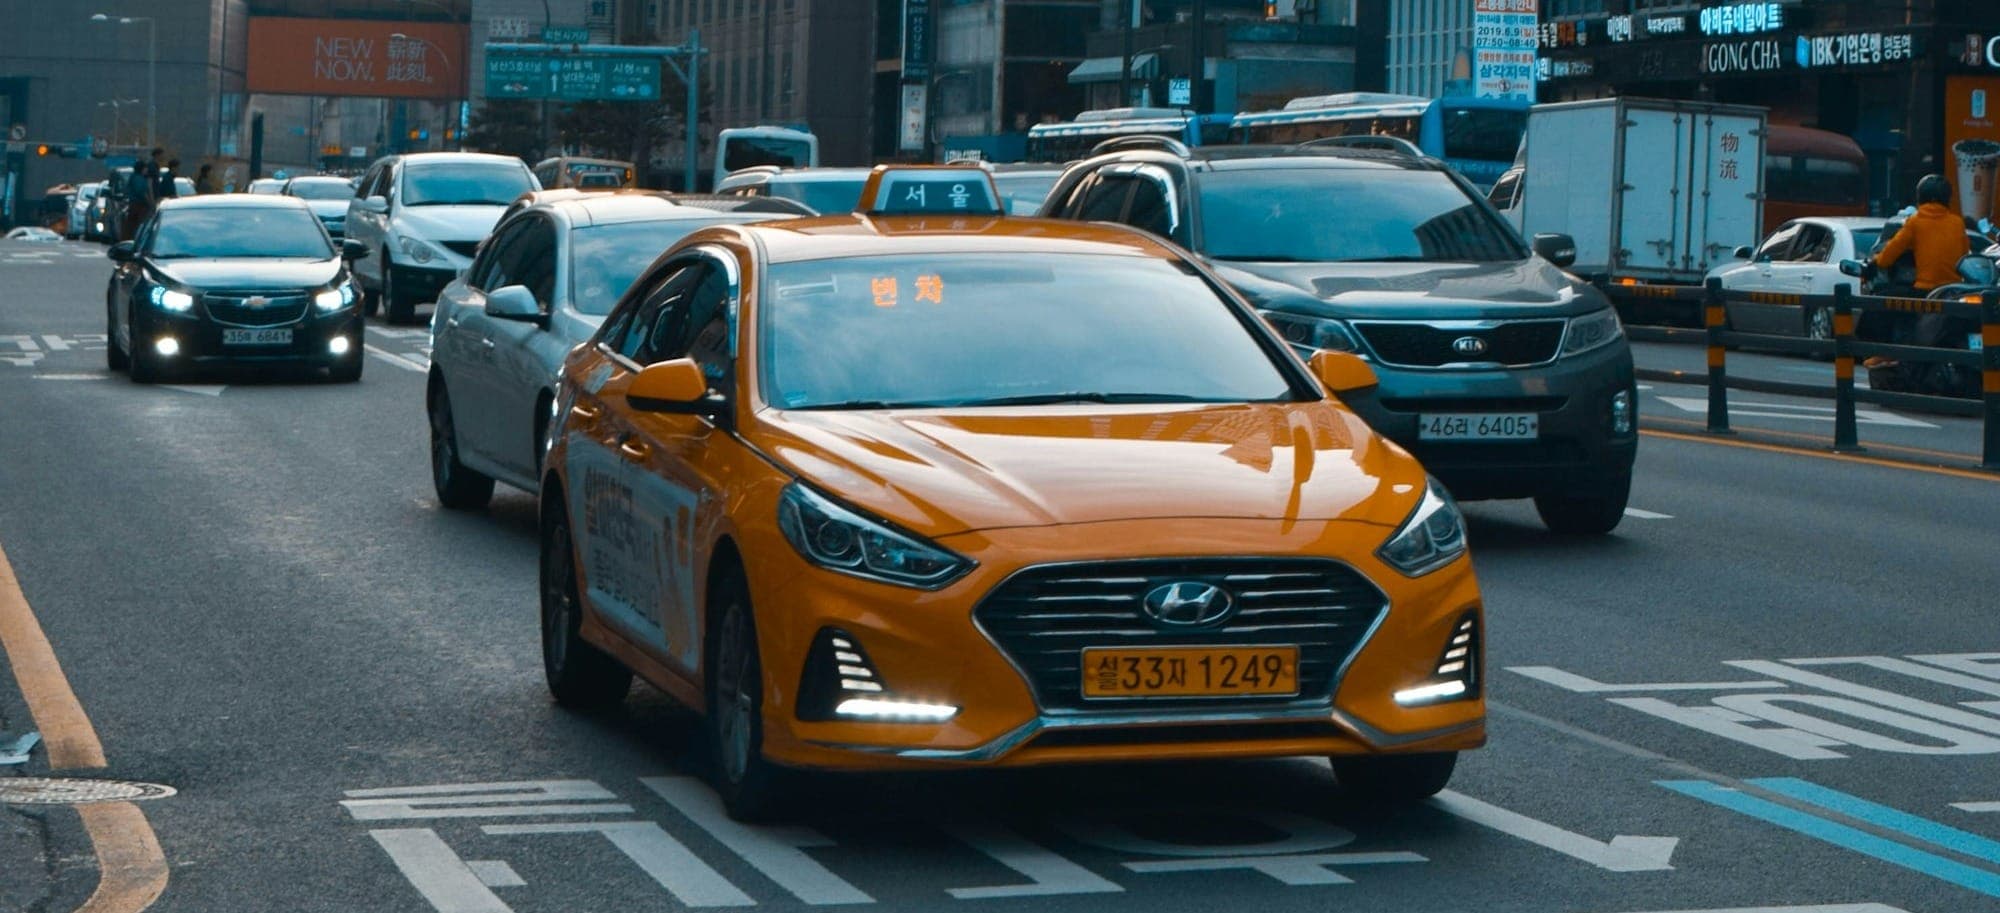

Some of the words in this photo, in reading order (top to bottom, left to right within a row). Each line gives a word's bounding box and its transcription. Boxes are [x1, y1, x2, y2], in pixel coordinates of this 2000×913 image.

[1701, 3, 1782, 35] 아비쥬네일아트
[314, 37, 374, 58] NEW
[1708, 43, 1748, 72] GONG
[1751, 41, 1781, 70] CHA
[314, 60, 376, 81] NOW.
[1480, 63, 1531, 79] 삼각지역
[1720, 132, 1739, 180] 物流
[905, 183, 971, 208] 서울
[1459, 340, 1483, 351] KIA
[1478, 415, 1528, 436] 6405
[1198, 654, 1283, 689] 1249
